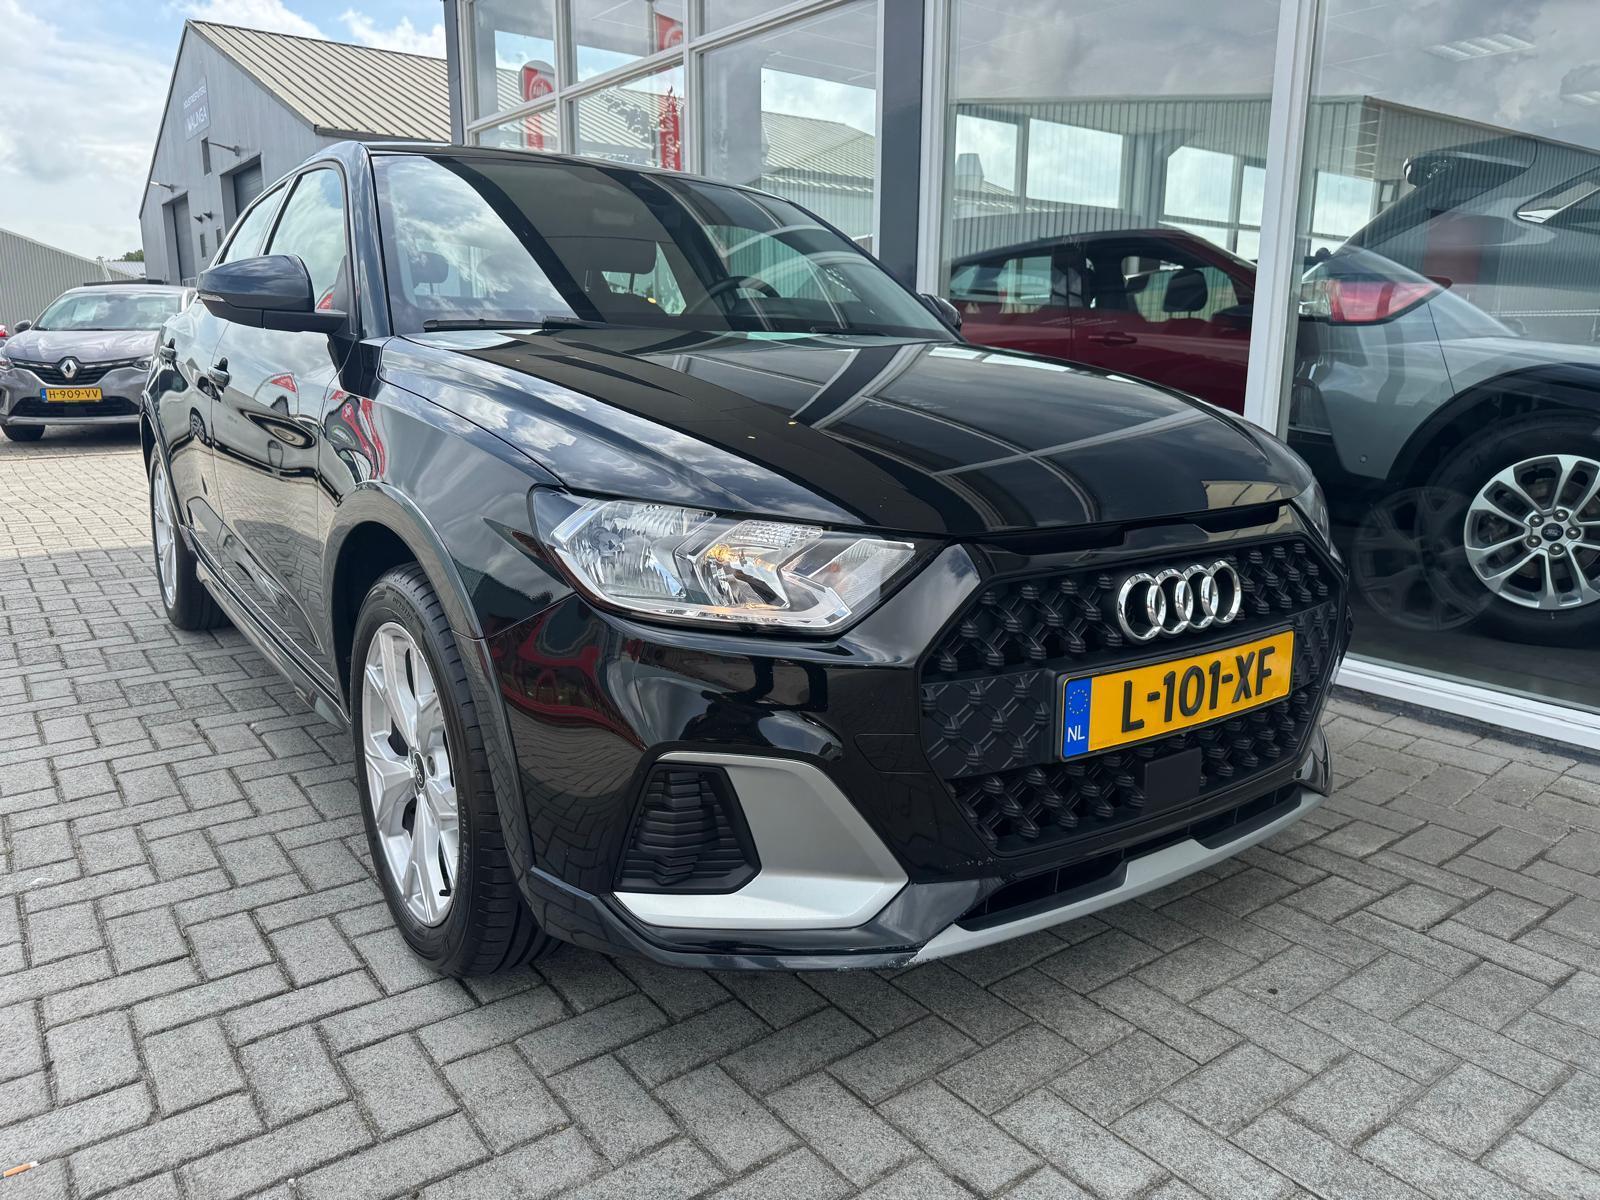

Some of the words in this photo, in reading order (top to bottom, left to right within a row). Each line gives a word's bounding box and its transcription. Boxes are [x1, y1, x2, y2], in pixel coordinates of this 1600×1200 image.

[48, 389, 98, 399] H-909-VV
[1121, 646, 1276, 733] L-101-XF
[1066, 724, 1086, 743] NL
